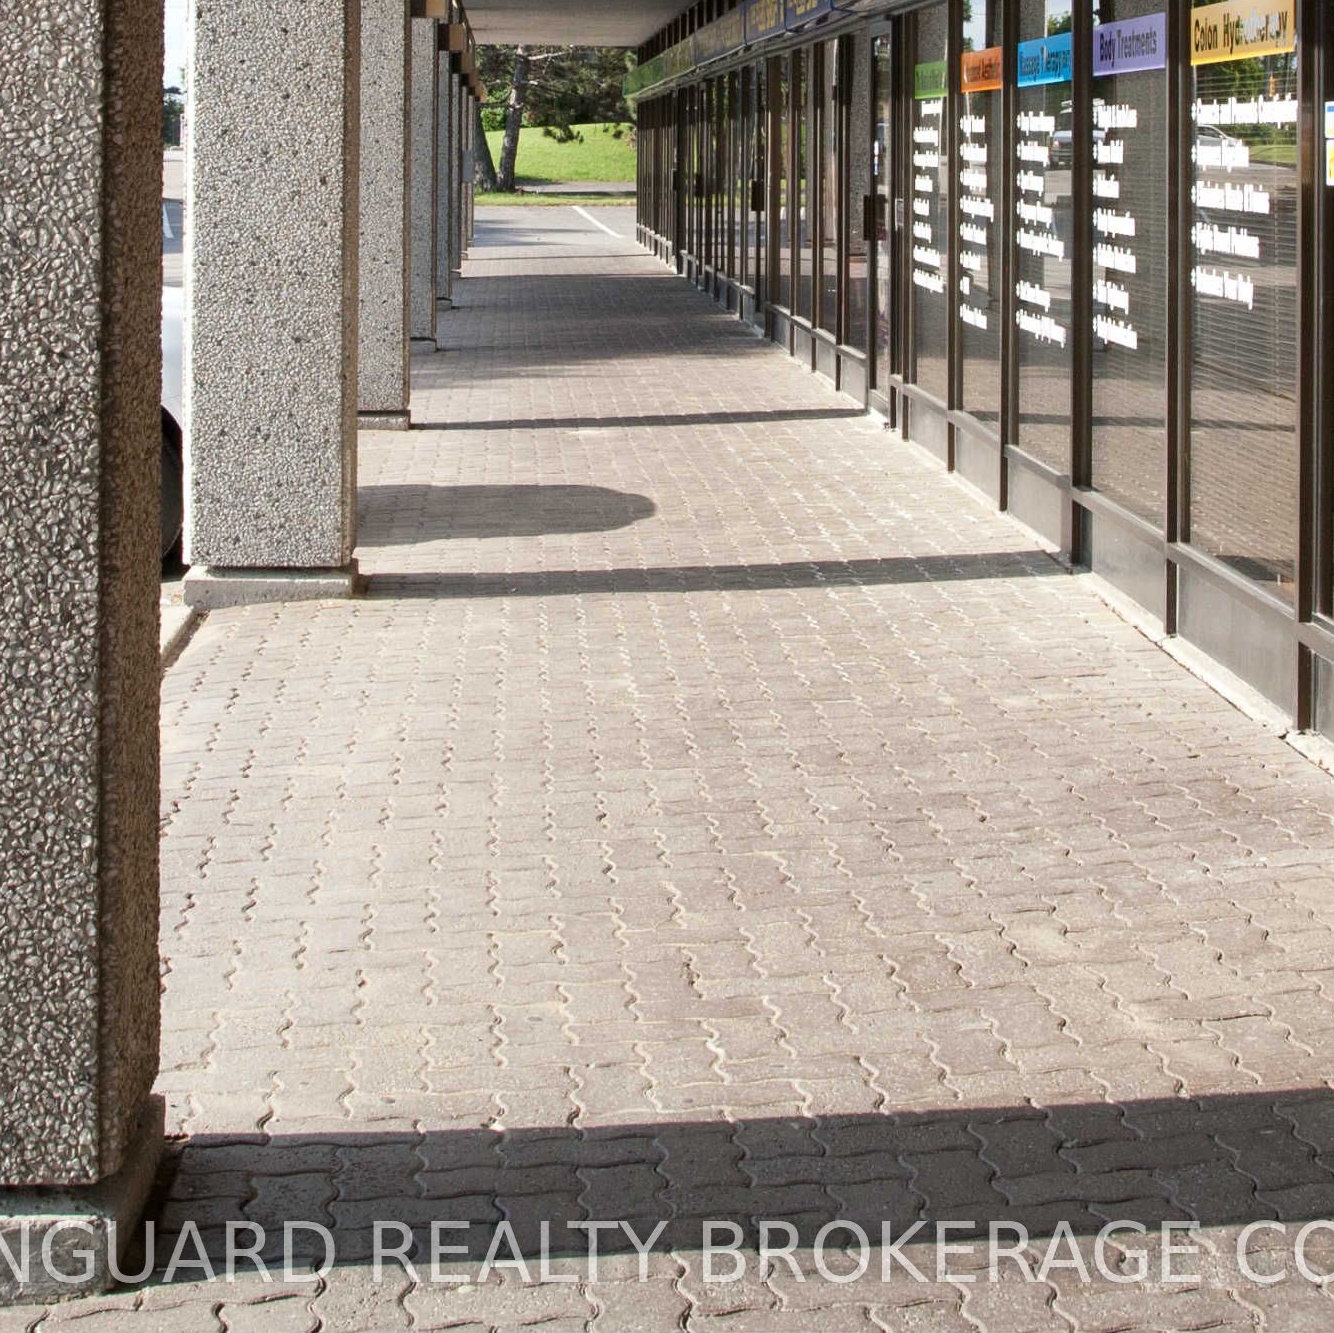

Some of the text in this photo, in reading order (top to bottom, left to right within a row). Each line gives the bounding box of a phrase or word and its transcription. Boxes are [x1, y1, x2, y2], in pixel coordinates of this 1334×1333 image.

[1099, 27, 1157, 68] Body Treatments
[1194, 18, 1219, 52] Colon
